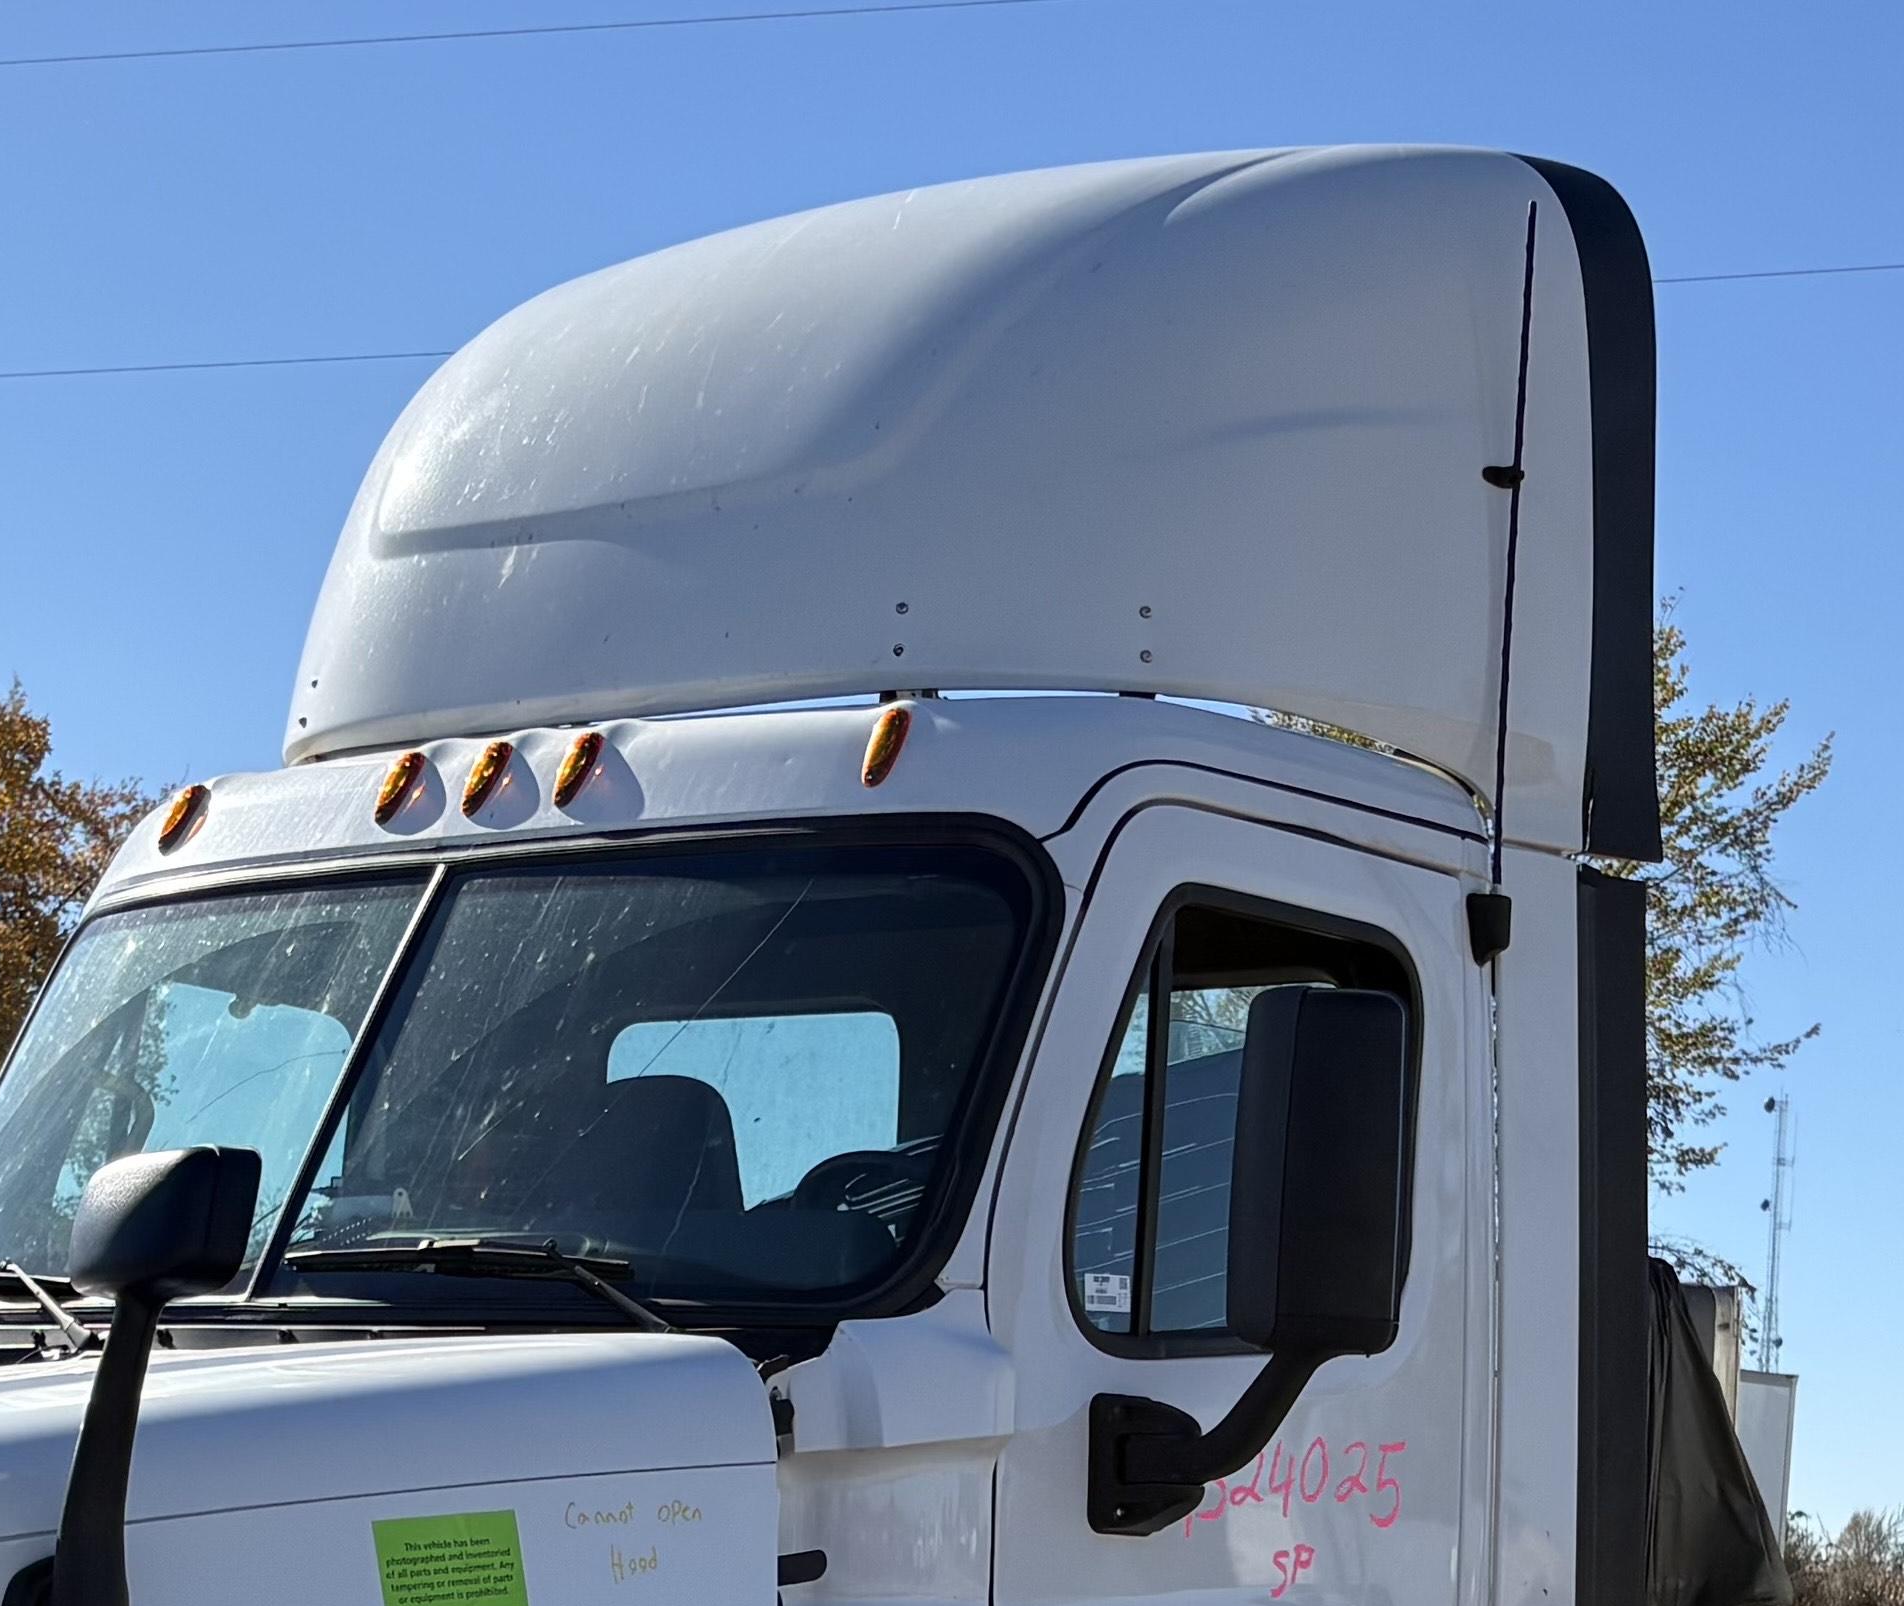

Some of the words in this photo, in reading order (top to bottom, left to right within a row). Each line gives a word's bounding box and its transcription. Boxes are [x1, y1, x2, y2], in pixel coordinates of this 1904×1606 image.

[565, 1501, 634, 1529] Cannot
[404, 1542, 421, 1552] This
[423, 1540, 452, 1550] vehicle
[454, 1539, 468, 1548] has
[470, 1538, 490, 1547] been
[386, 1552, 446, 1568] photographed
[448, 1551, 464, 1560] and
[465, 1547, 511, 1559] inventoried
[386, 1570, 395, 1579] of
[398, 1568, 408, 1578] all
[410, 1568, 432, 1578] parts
[433, 1566, 449, 1575] and
[499, 1560, 515, 1571] Any
[1269, 1543, 1315, 1598] SP
[391, 1581, 435, 1593] tampering
[437, 1580, 445, 1588] or
[448, 1575, 481, 1587] removal
[482, 1574, 491, 1584] of
[493, 1574, 514, 1584] parts
[398, 1597, 408, 1605] or
[410, 1592, 455, 1604] equipment
[456, 1591, 464, 1600] is
